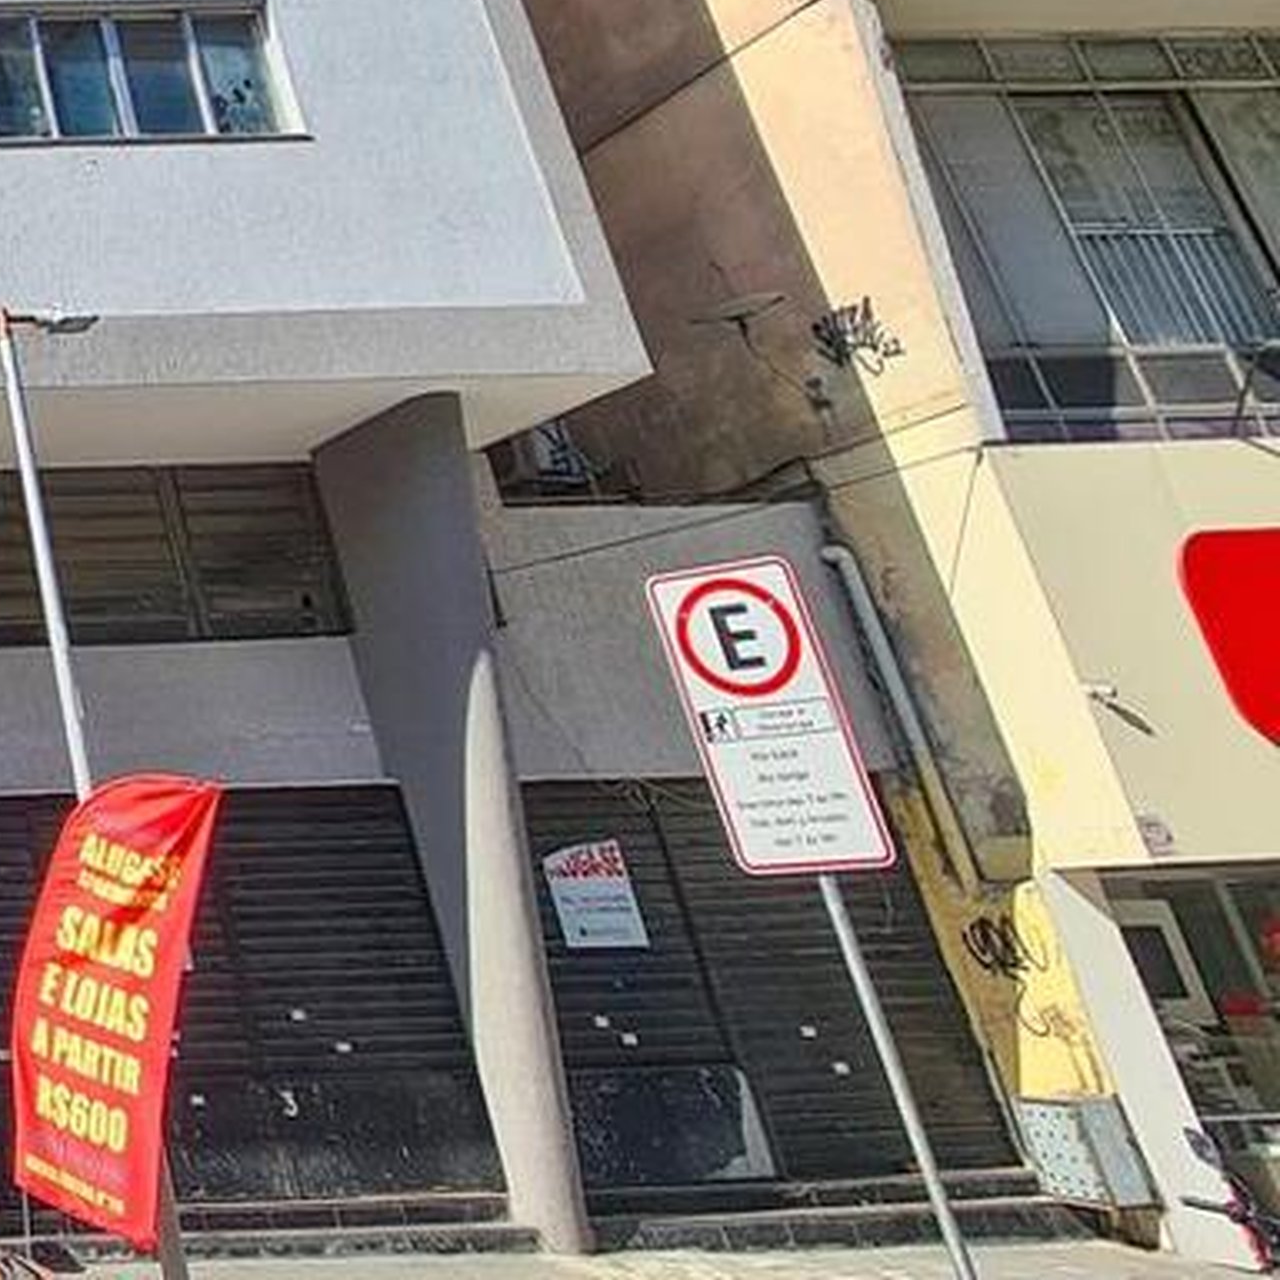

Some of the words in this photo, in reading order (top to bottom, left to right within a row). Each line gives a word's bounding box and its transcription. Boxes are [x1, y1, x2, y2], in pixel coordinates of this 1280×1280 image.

[708, 602, 767, 672] E
[56, 905, 159, 979] SALAS
[41, 962, 59, 1007] E
[60, 969, 150, 1043] LOJAS
[31, 1018, 50, 1060] A
[51, 1026, 141, 1096] PARTIR
[35, 1072, 128, 1153] R$600
